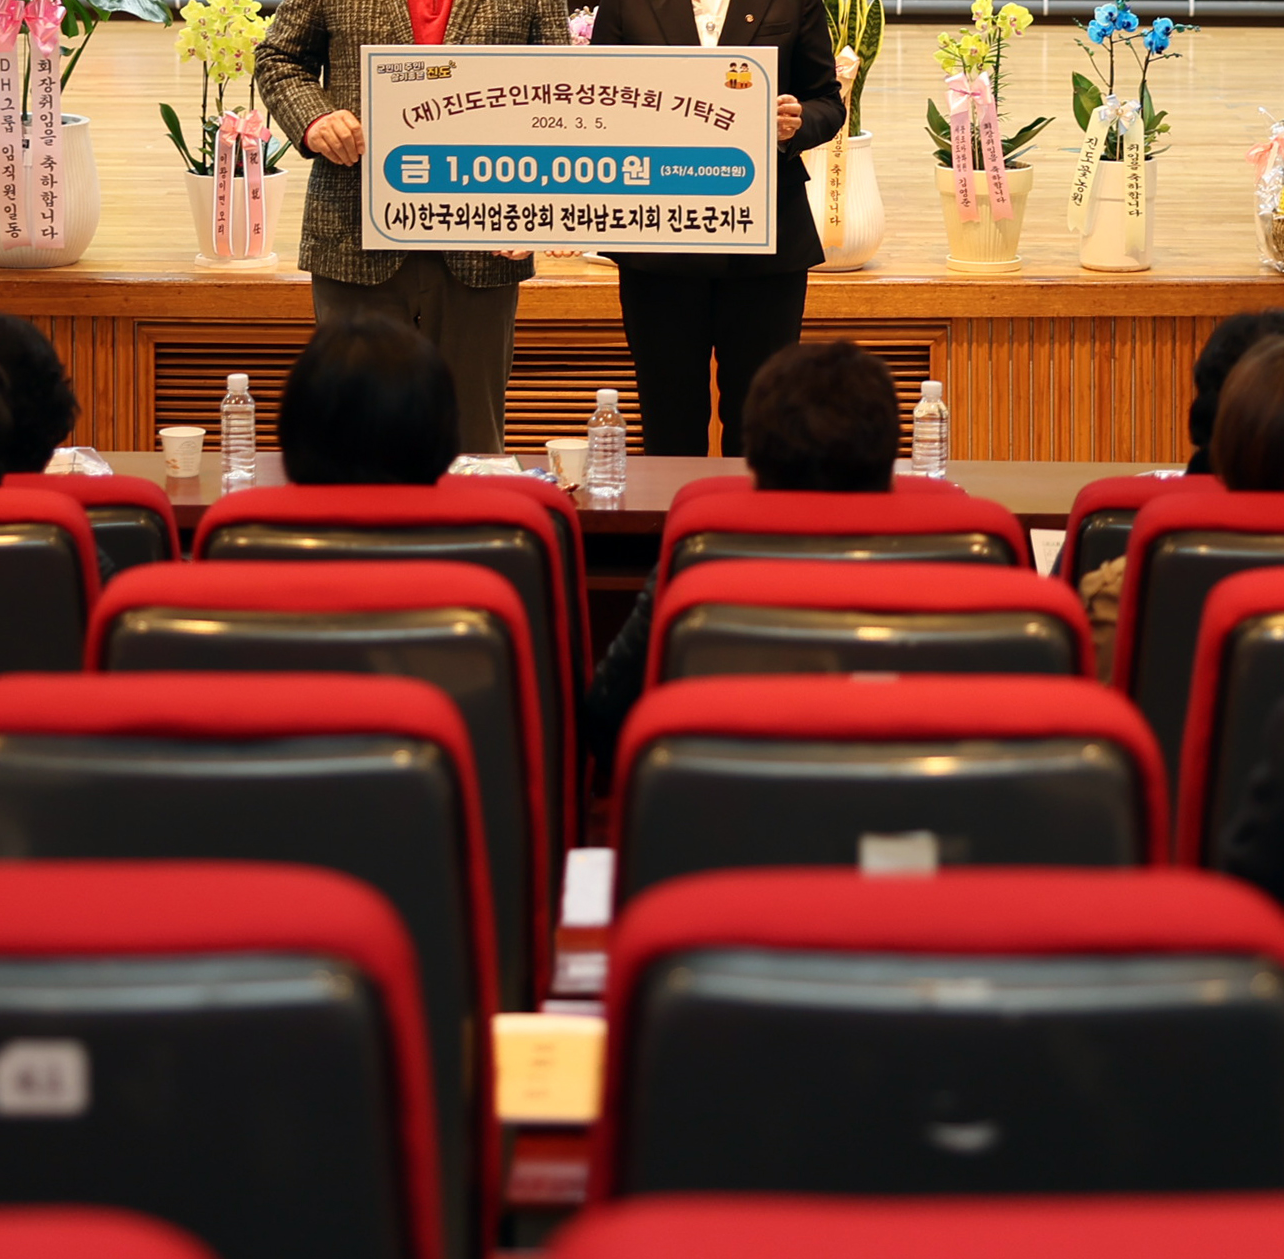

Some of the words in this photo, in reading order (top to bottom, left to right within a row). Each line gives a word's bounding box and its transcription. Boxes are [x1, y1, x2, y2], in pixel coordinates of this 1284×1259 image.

[0, 59, 16, 133] DH그룹
[426, 65, 452, 80] 진도
[37, 58, 57, 146] 회장취임을
[402, 84, 662, 130] (재)진도군인재육성장학회
[670, 94, 736, 131] 기탁금
[531, 116, 568, 130] 2024.
[575, 116, 588, 130] 3.
[594, 116, 607, 130] 5.
[2, 144, 22, 239] 임직원일동
[400, 154, 430, 183] 금
[446, 155, 651, 187] 1,000,000원
[660, 165, 746, 178] (3차/4,000천원)
[39, 155, 58, 240] 축하합니다
[384, 202, 554, 231] (사)한국외식업중앙회
[560, 204, 660, 232] 전라남도지회
[667, 206, 754, 234] 진도군지부
[829, 163, 842, 226] 축하합니다
[1127, 173, 1143, 217] 축하합니다
